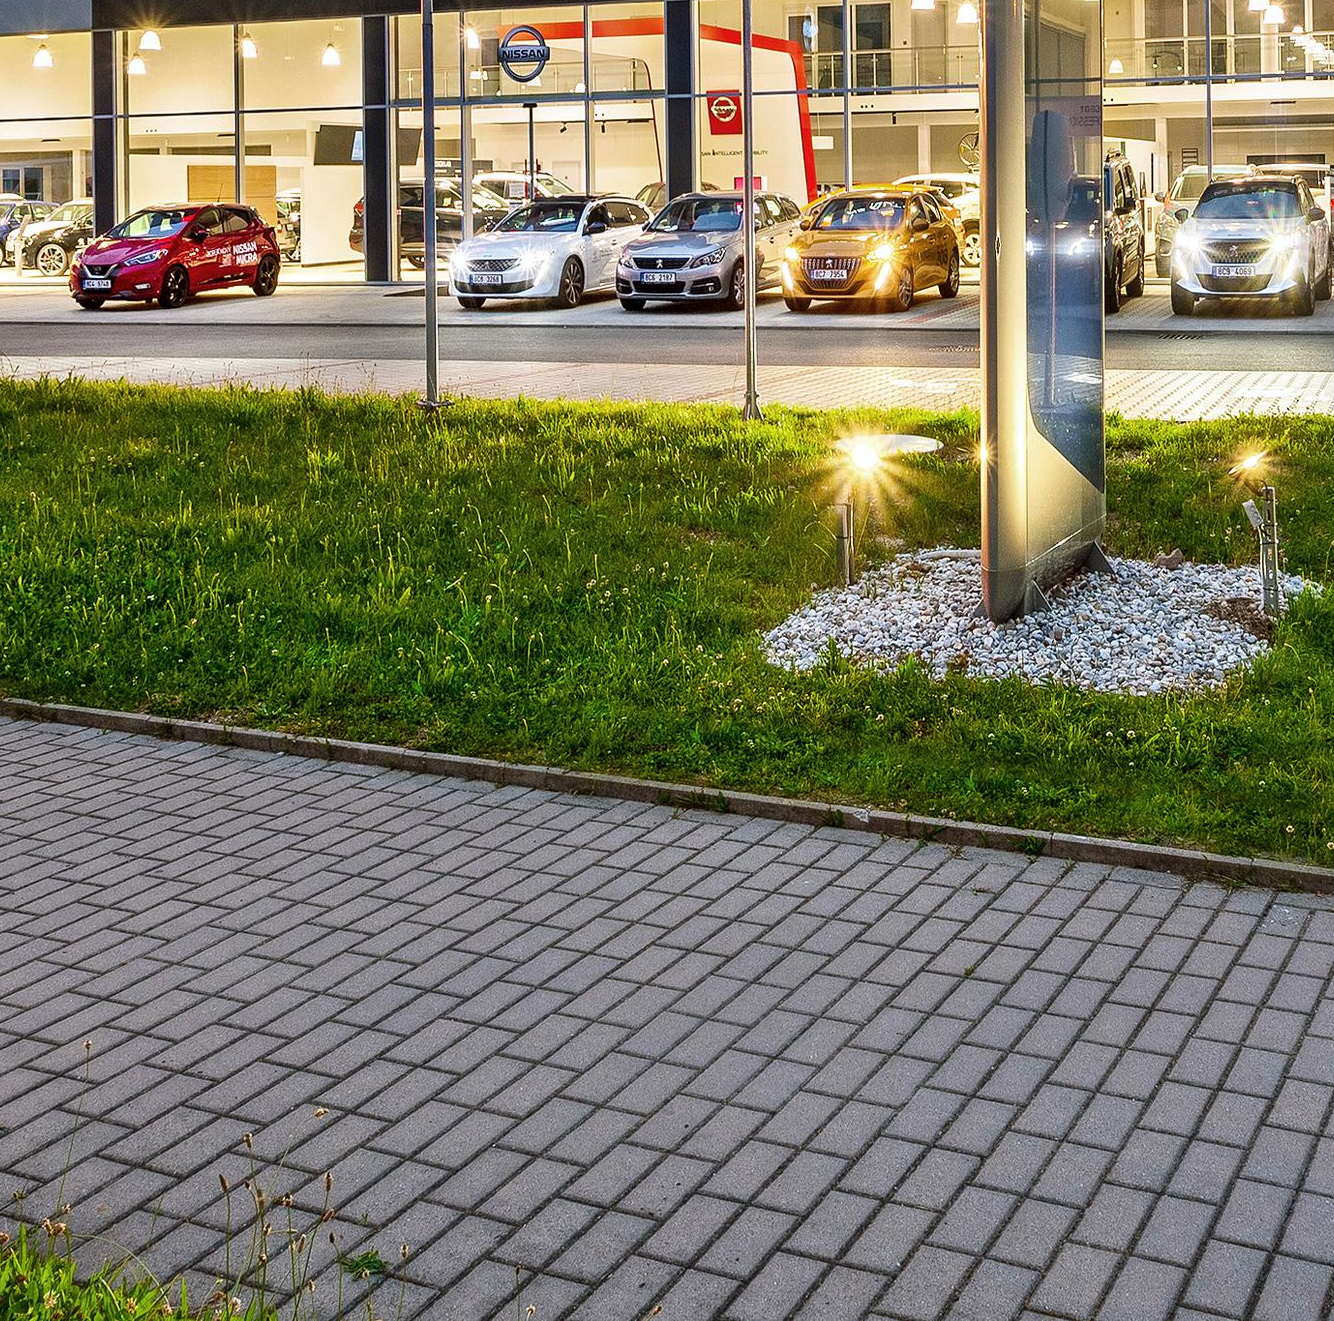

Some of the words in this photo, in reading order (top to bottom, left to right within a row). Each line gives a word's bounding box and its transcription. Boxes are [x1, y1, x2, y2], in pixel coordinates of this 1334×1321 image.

[502, 48, 546, 59] NISSAN
[232, 241, 258, 255] NISSAN
[235, 252, 258, 265] MICRA
[1217, 267, 1231, 276] 8C9
